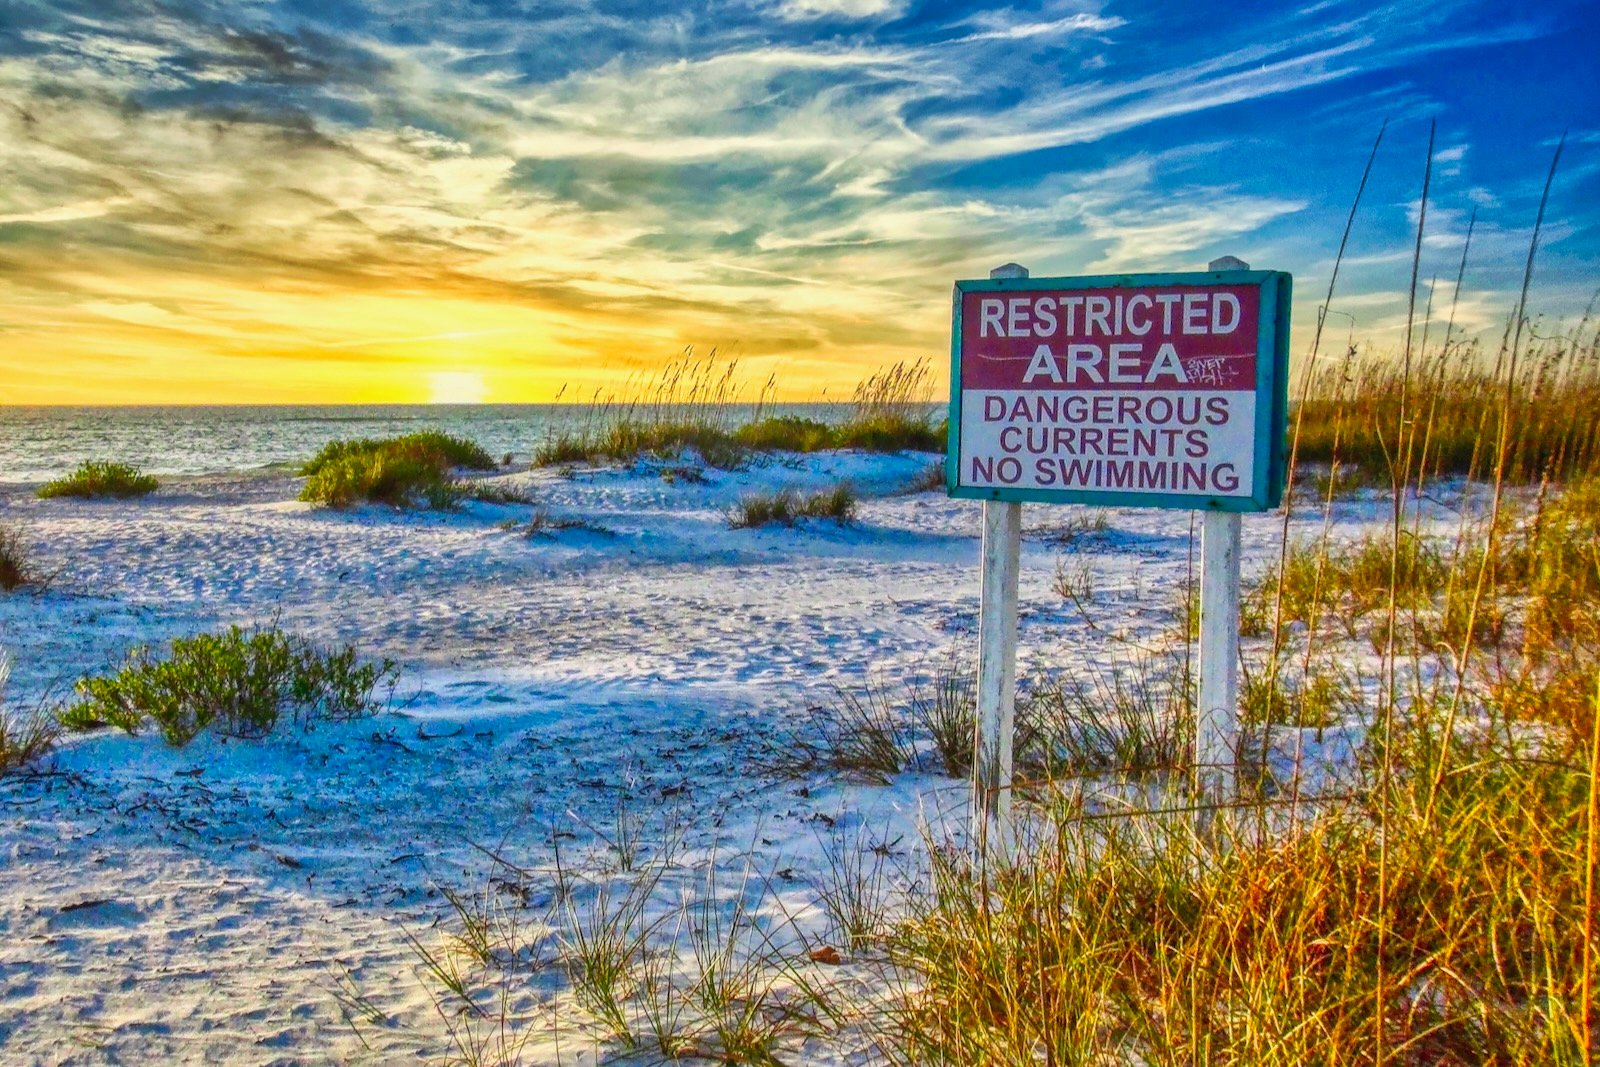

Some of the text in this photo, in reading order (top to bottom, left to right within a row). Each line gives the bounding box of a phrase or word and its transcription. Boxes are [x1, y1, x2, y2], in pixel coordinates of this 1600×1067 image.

[980, 293, 1241, 338] RESTRICTED
[1022, 343, 1189, 384] AREA
[984, 396, 1229, 425] DANGEROUS
[1000, 427, 1209, 457] CURRENTS
[972, 457, 1239, 492] NO SWIMMING
